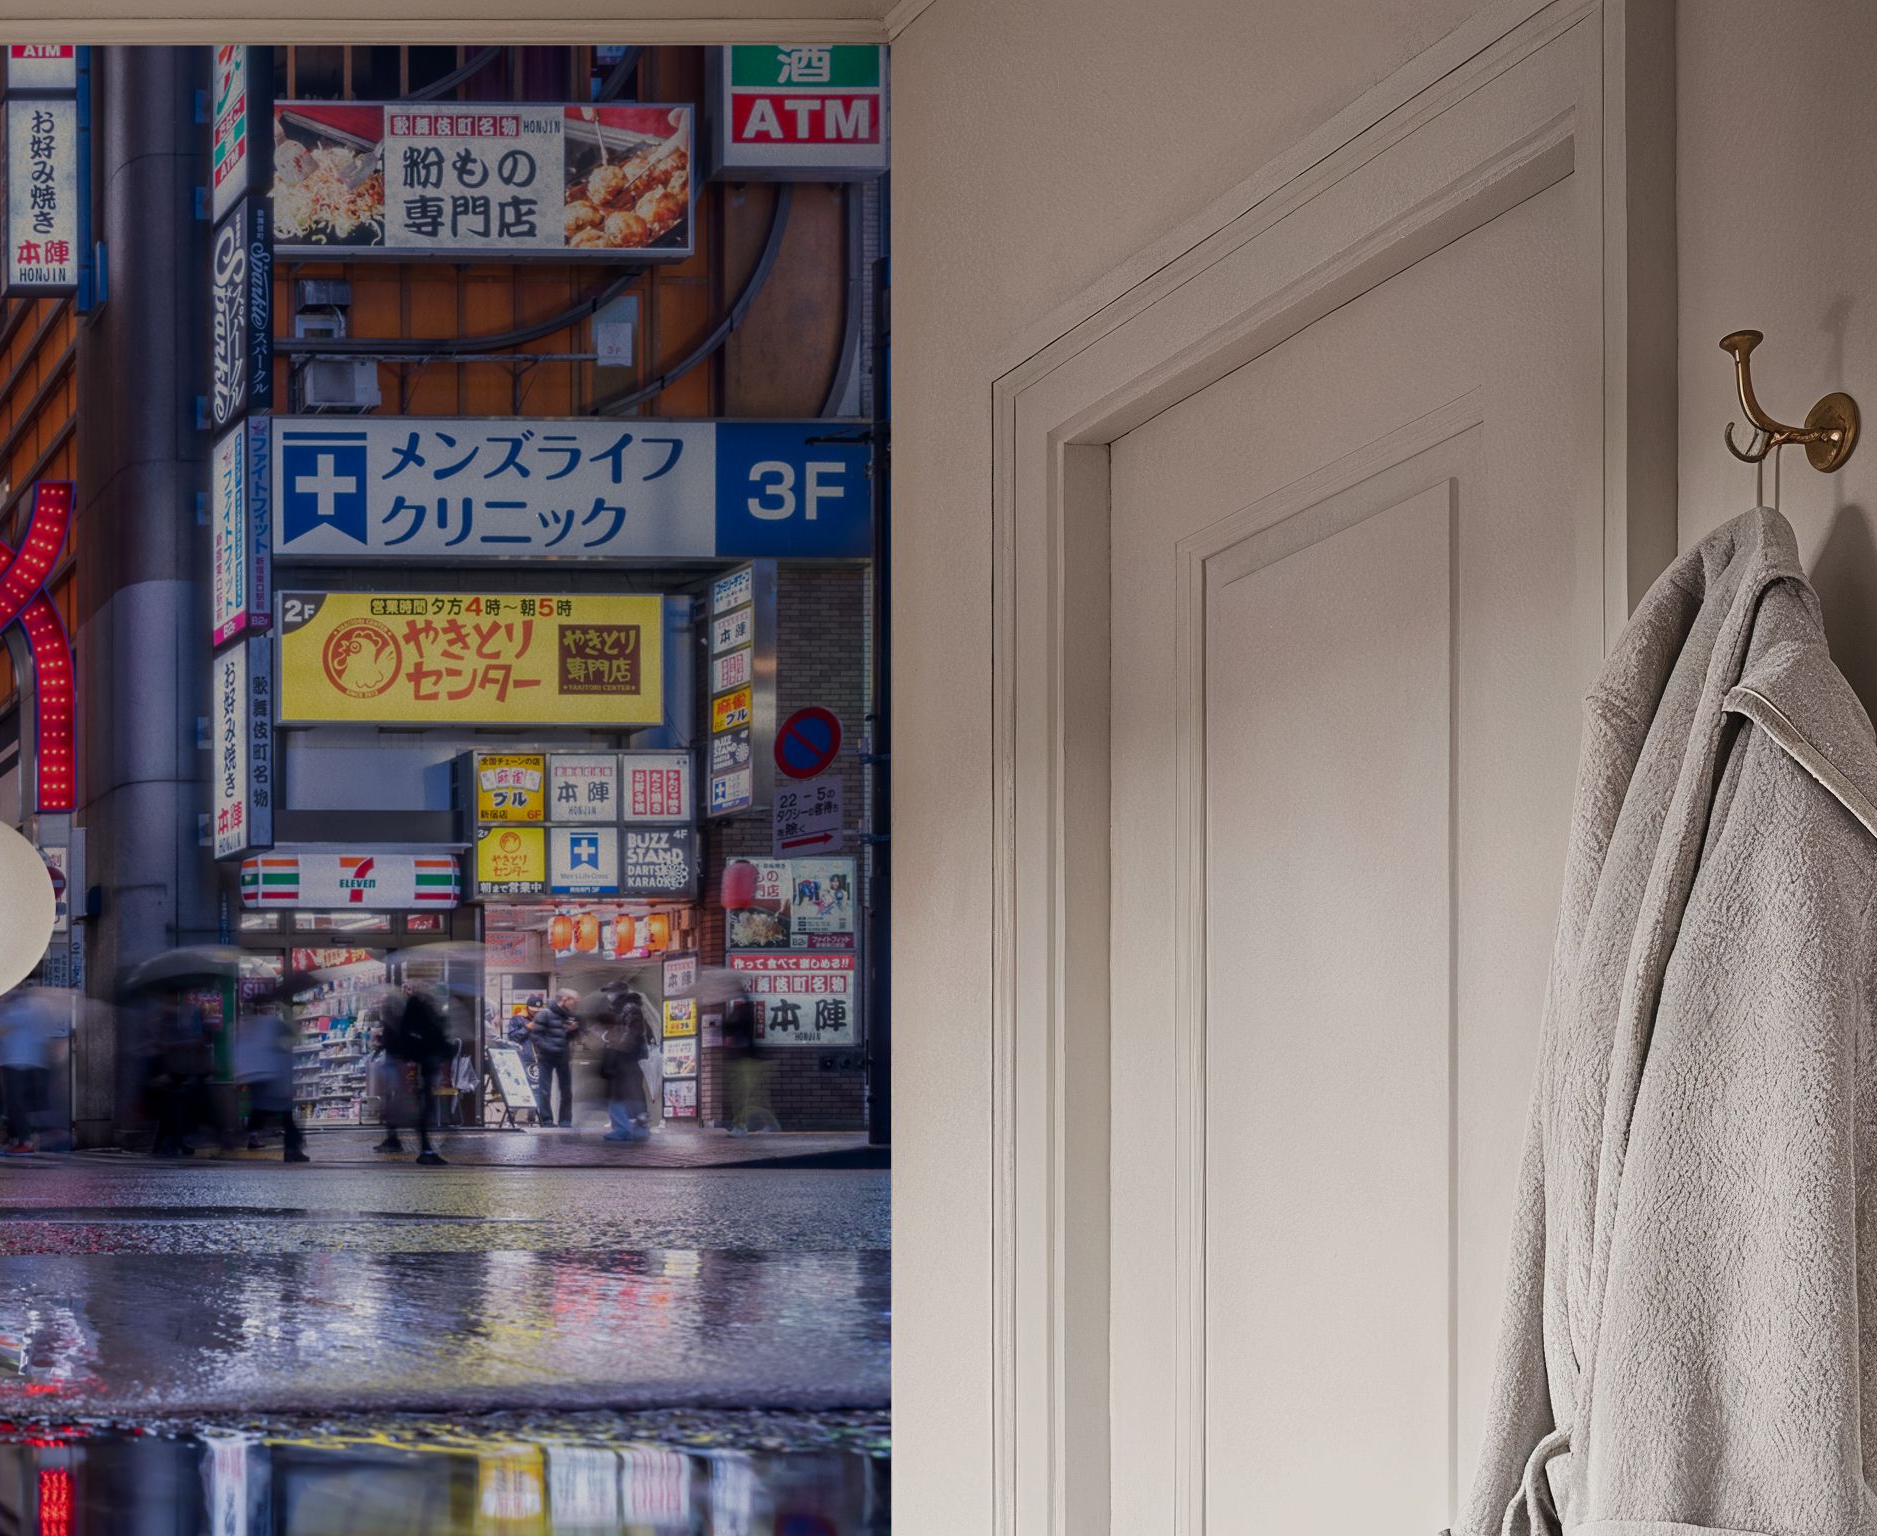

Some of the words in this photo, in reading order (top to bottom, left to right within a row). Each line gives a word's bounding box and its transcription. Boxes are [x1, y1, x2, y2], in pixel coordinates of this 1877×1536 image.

[23, 45, 61, 56] ATM
[776, 45, 834, 84] 酒
[392, 116, 518, 136] 歌舞伎町名物
[523, 120, 561, 134] HONJIN
[741, 98, 871, 139] ATM
[29, 110, 57, 235] お好み焼き
[402, 146, 537, 189] 粉もの
[403, 194, 538, 239] 専門店
[17, 239, 71, 266] 本陣
[19, 267, 67, 282] HONJIN
[251, 242, 271, 330] Sparkle
[213, 225, 246, 415] Sparkle
[228, 283, 246, 417] スパークル
[252, 331, 270, 395] スパークル
[381, 429, 684, 485] メンズライフ
[250, 437, 268, 554] ファイトフィット
[747, 460, 846, 521] 3F
[381, 495, 627, 548] クリニック
[223, 469, 234, 617] ファイトフィット
[284, 599, 316, 623] 2F
[372, 599, 427, 615] 営業時間
[402, 618, 534, 661] やきとり
[562, 628, 637, 655] やきとり
[404, 660, 542, 703] センター
[566, 657, 632, 684] 専門店
[223, 662, 236, 799] お好み焼き
[725, 709, 748, 726] ブル
[252, 675, 269, 809] 歌舞伎町名物
[493, 791, 528, 808] ブル
[556, 780, 611, 804] 本陣
[780, 793, 797, 809] 22
[218, 801, 243, 836] 本陣
[526, 809, 543, 820] 6F
[627, 832, 670, 849] BUZZ
[672, 829, 689, 840] 4F
[627, 847, 684, 865] STAND
[769, 998, 848, 1032] 本陣
